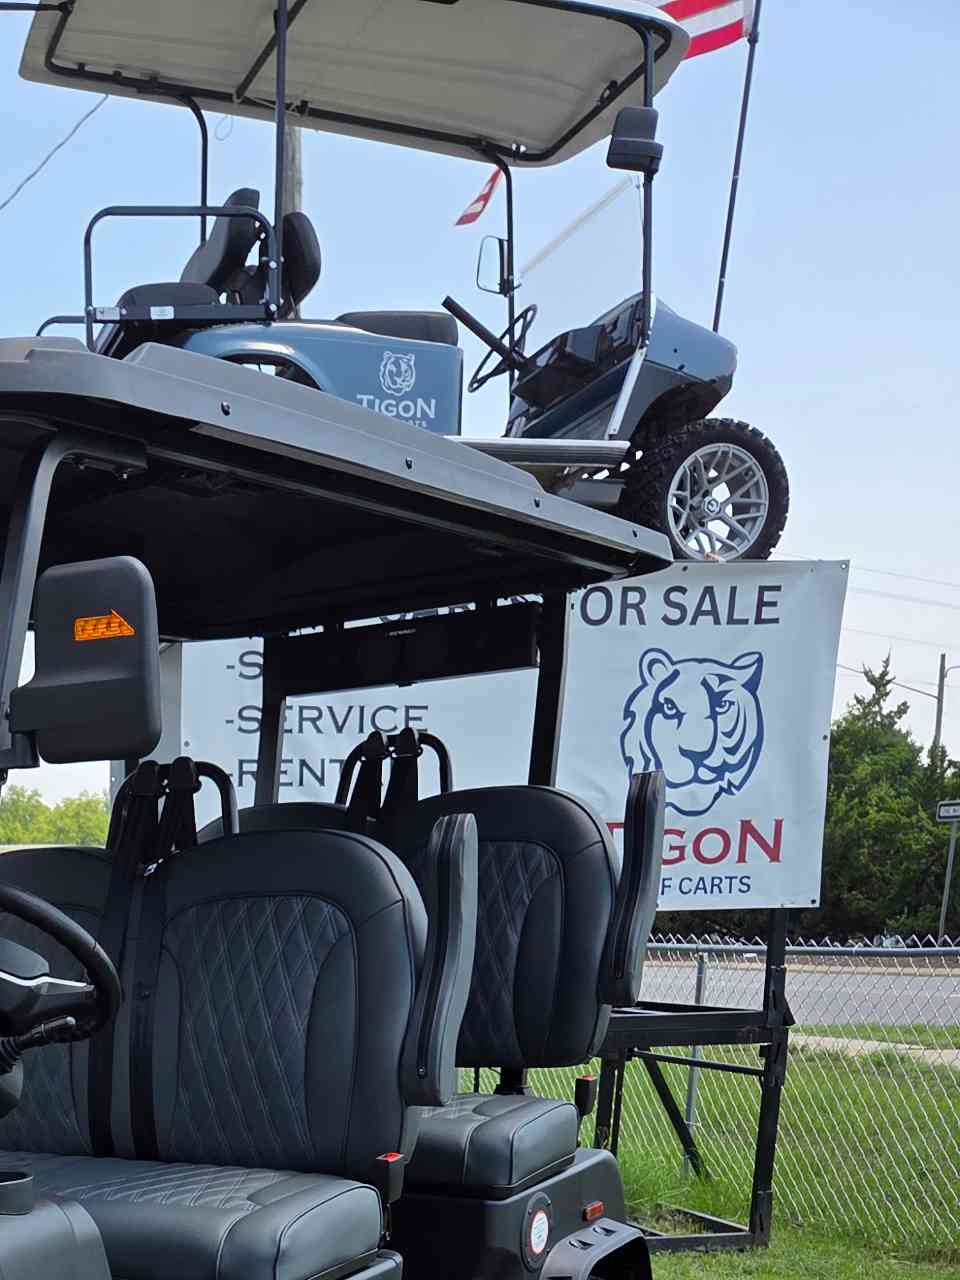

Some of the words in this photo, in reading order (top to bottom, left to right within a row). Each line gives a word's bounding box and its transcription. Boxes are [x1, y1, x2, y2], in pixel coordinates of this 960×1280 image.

[356, 394, 436, 419] TIGON
[571, 585, 647, 626] OR
[661, 585, 782, 626] SALE
[607, 816, 784, 866] GON
[678, 875, 751, 895] CARTS
